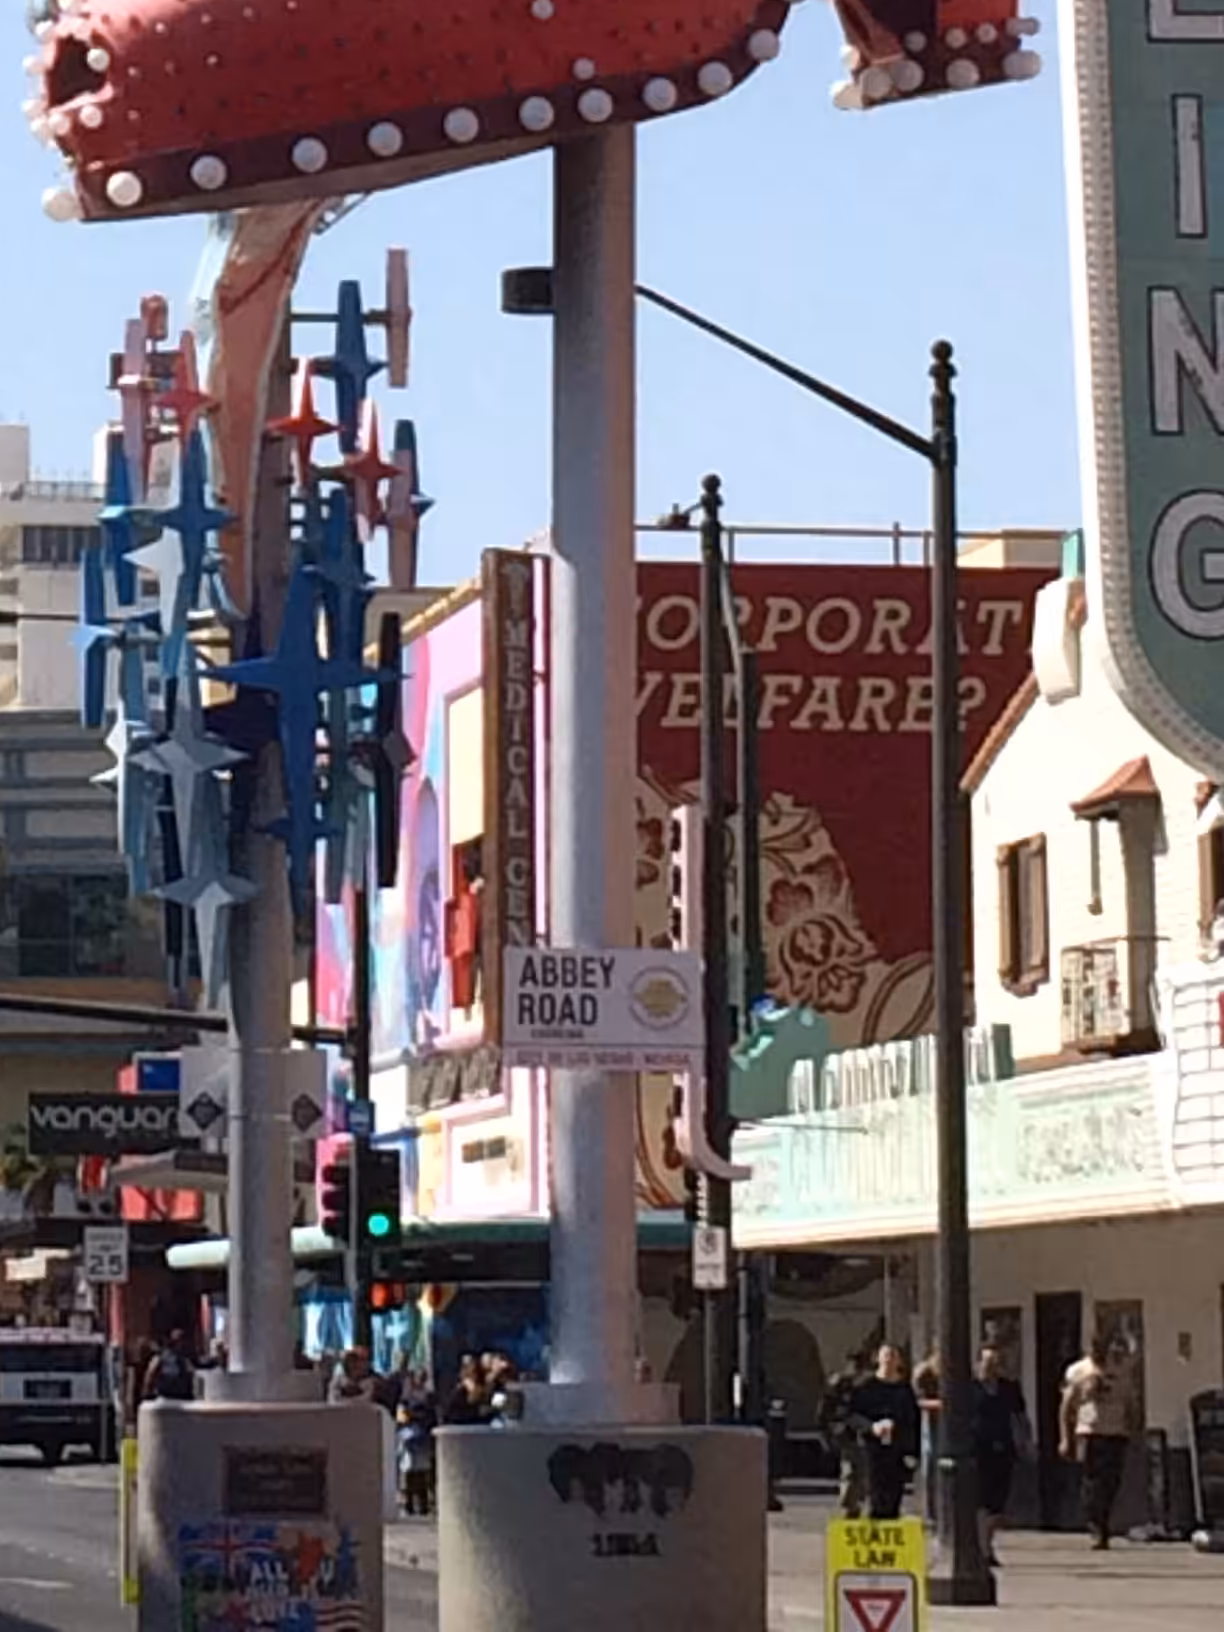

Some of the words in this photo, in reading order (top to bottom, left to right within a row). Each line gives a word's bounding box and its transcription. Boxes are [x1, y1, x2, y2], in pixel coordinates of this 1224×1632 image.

[505, 620, 528, 838] MEDICAL
[505, 858, 528, 946] CEN
[519, 955, 615, 988] ABBEY
[518, 992, 598, 1026] ROAD
[30, 1104, 177, 1138] vanguar
[89, 1254, 122, 1276] 25
[845, 1526, 905, 1546] STATE
[854, 1550, 896, 1568] LAW
